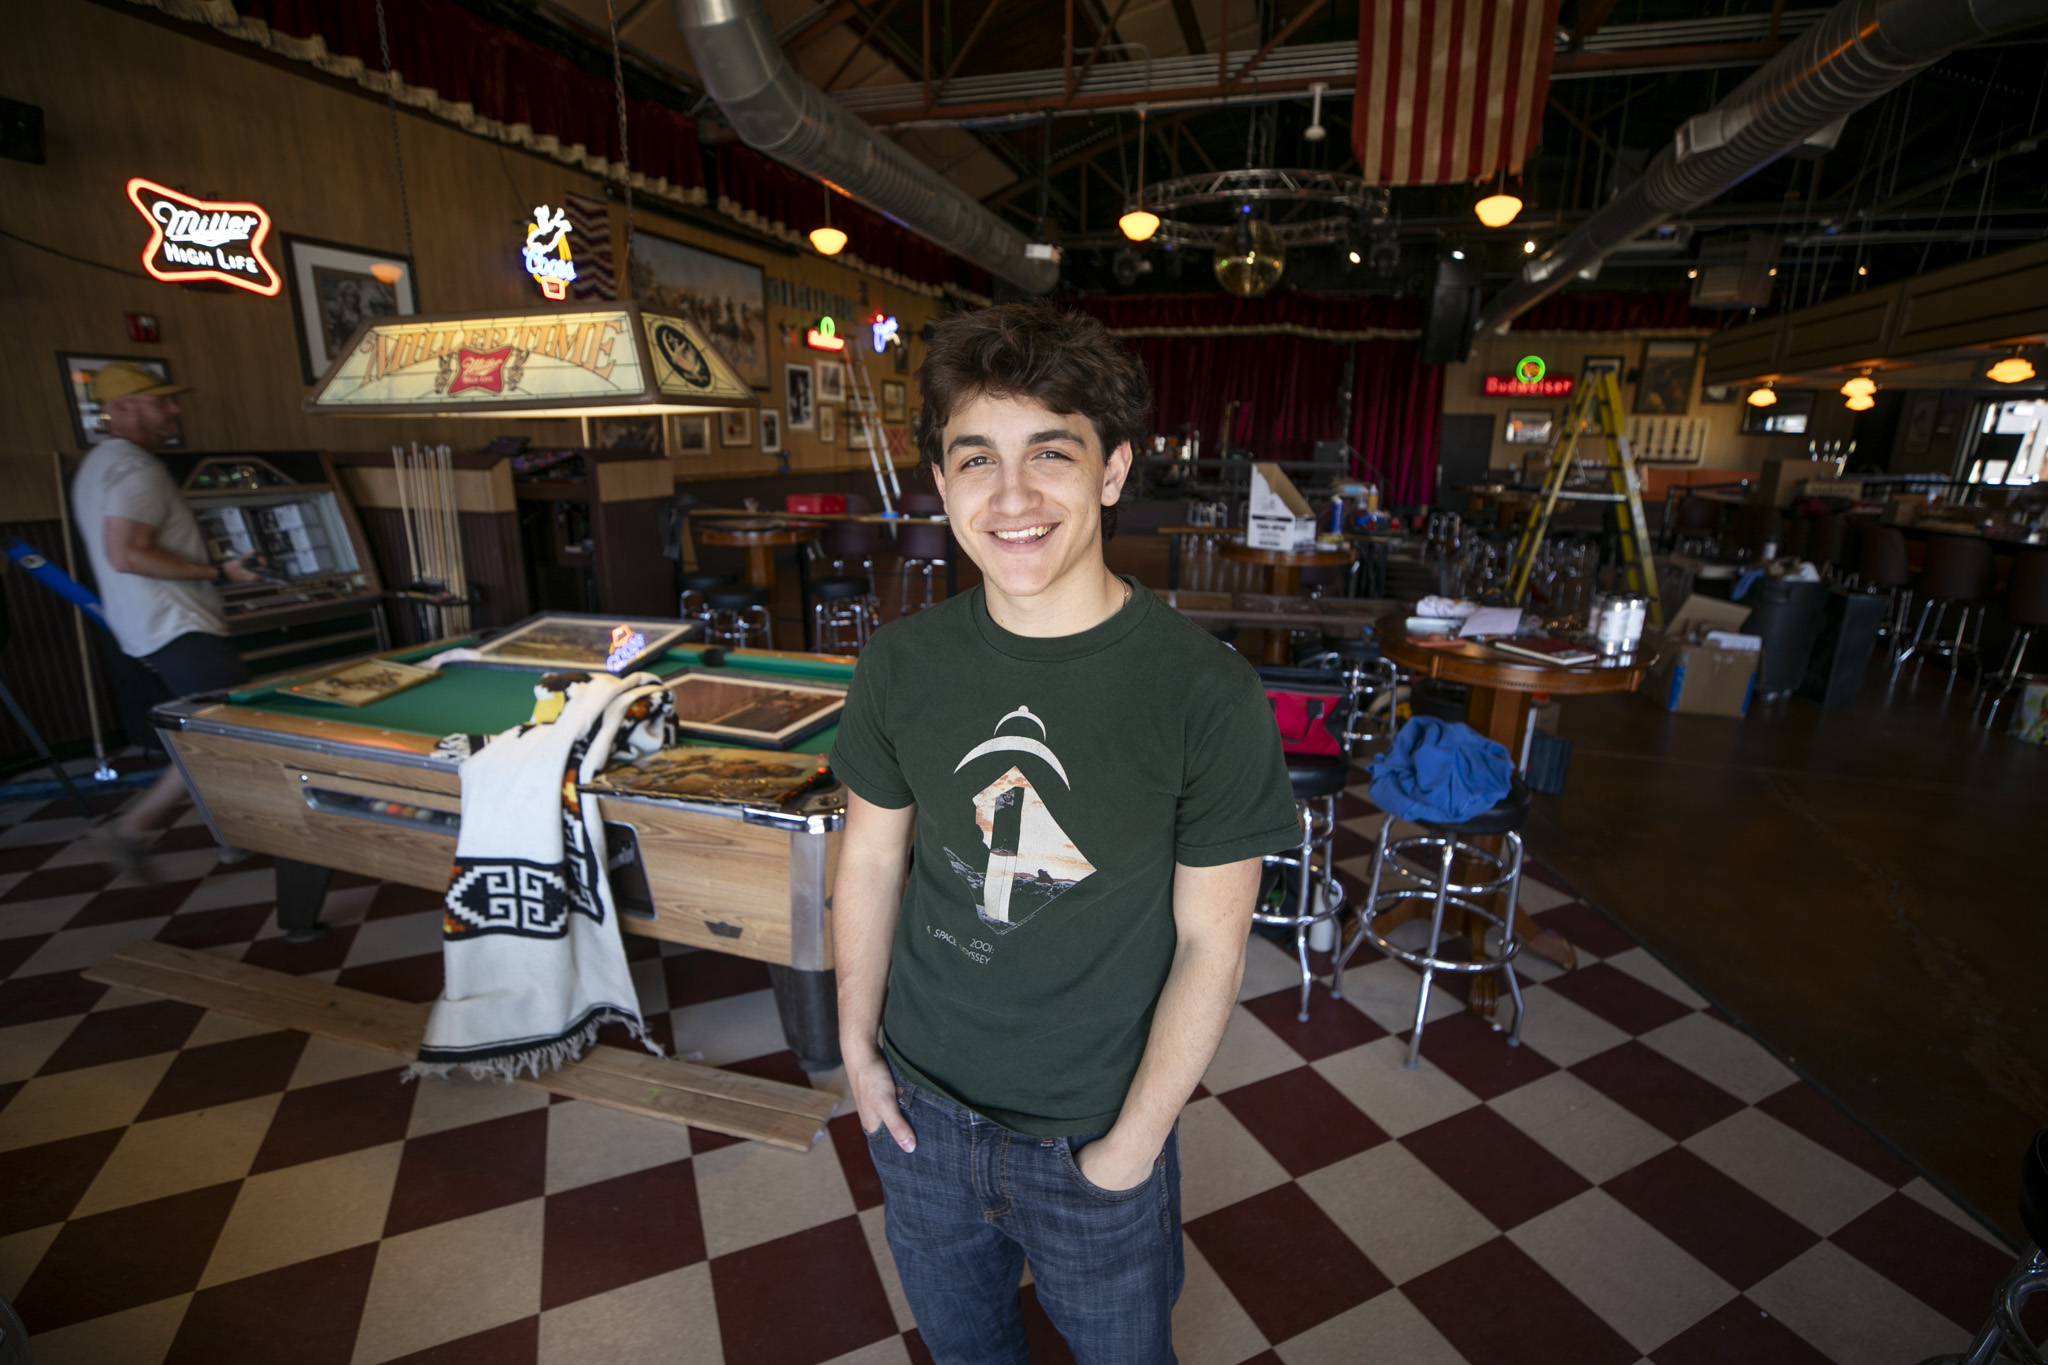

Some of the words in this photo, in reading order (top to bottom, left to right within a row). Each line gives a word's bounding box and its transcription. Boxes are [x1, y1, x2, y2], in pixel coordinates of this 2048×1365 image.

[152, 201, 258, 239] Miller
[522, 246, 577, 282] Coors
[360, 328, 507, 387] MILLER
[514, 320, 622, 380] TIME
[1485, 376, 1573, 395] Budweiser
